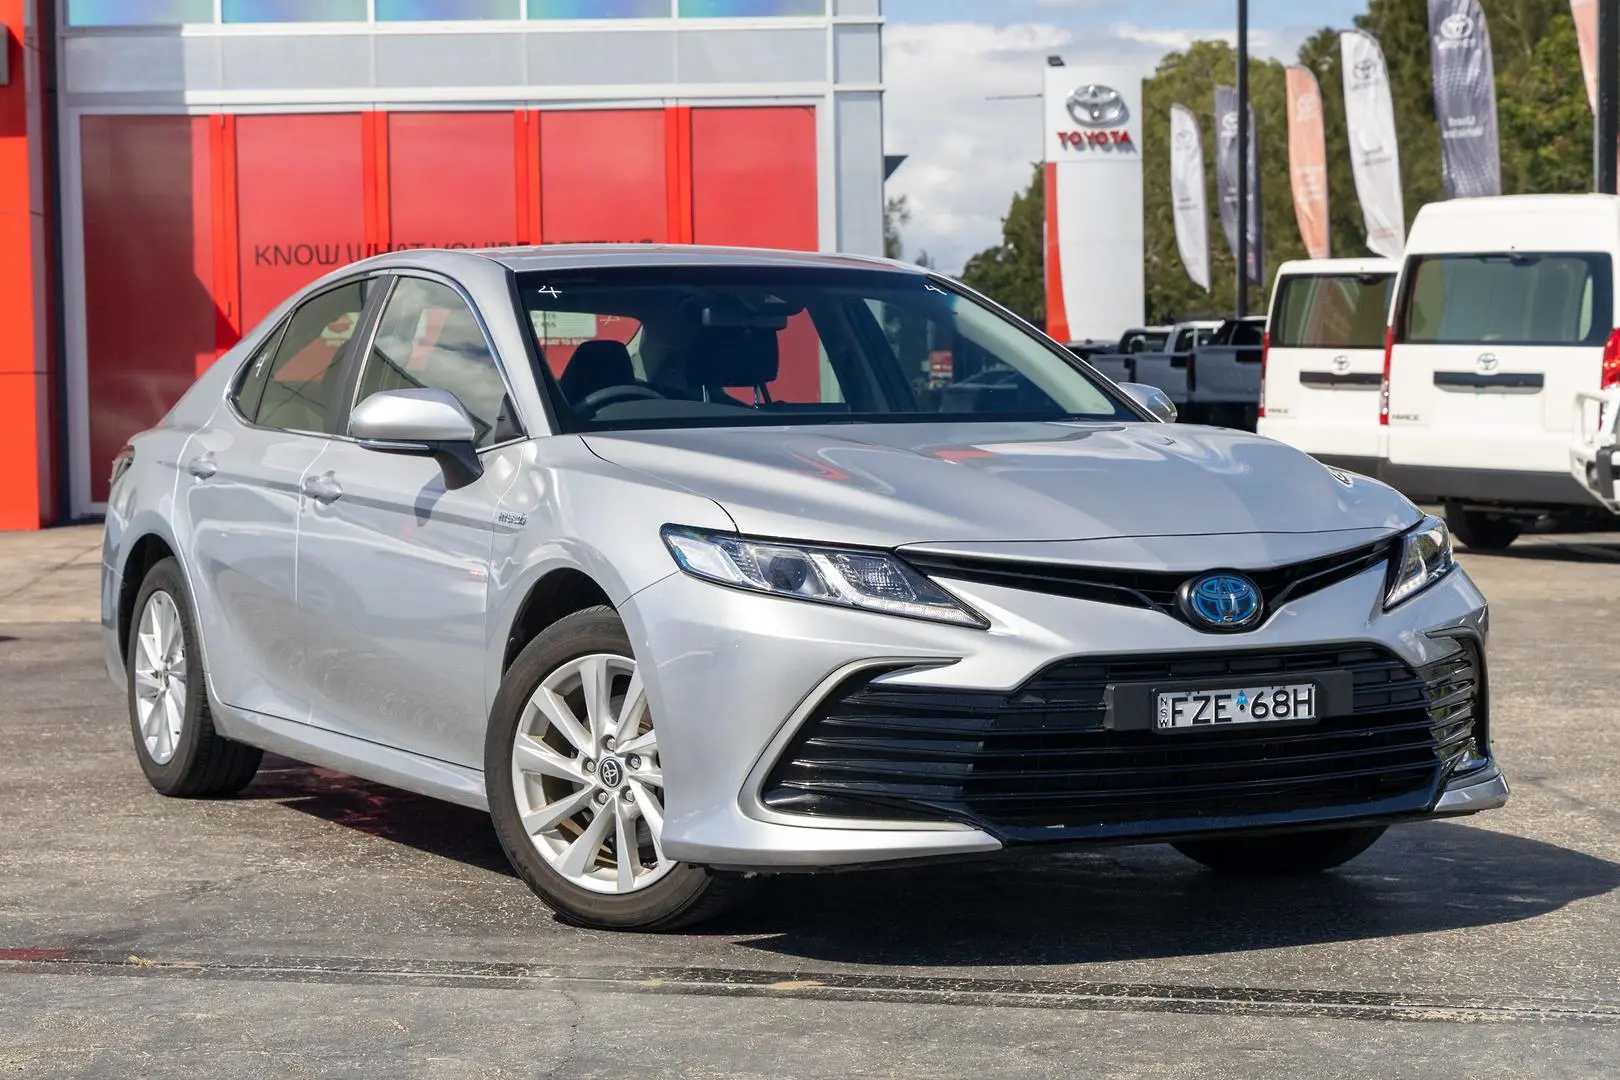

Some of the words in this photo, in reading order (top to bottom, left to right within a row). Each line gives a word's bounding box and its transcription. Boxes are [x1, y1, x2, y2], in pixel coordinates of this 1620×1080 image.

[1057, 130, 1130, 146] TOYOTA
[255, 243, 339, 266] KNOW
[347, 243, 426, 263] WH
[1159, 697, 1169, 727] NSW
[1171, 693, 1233, 727] FZE
[1250, 688, 1313, 720] 68H
